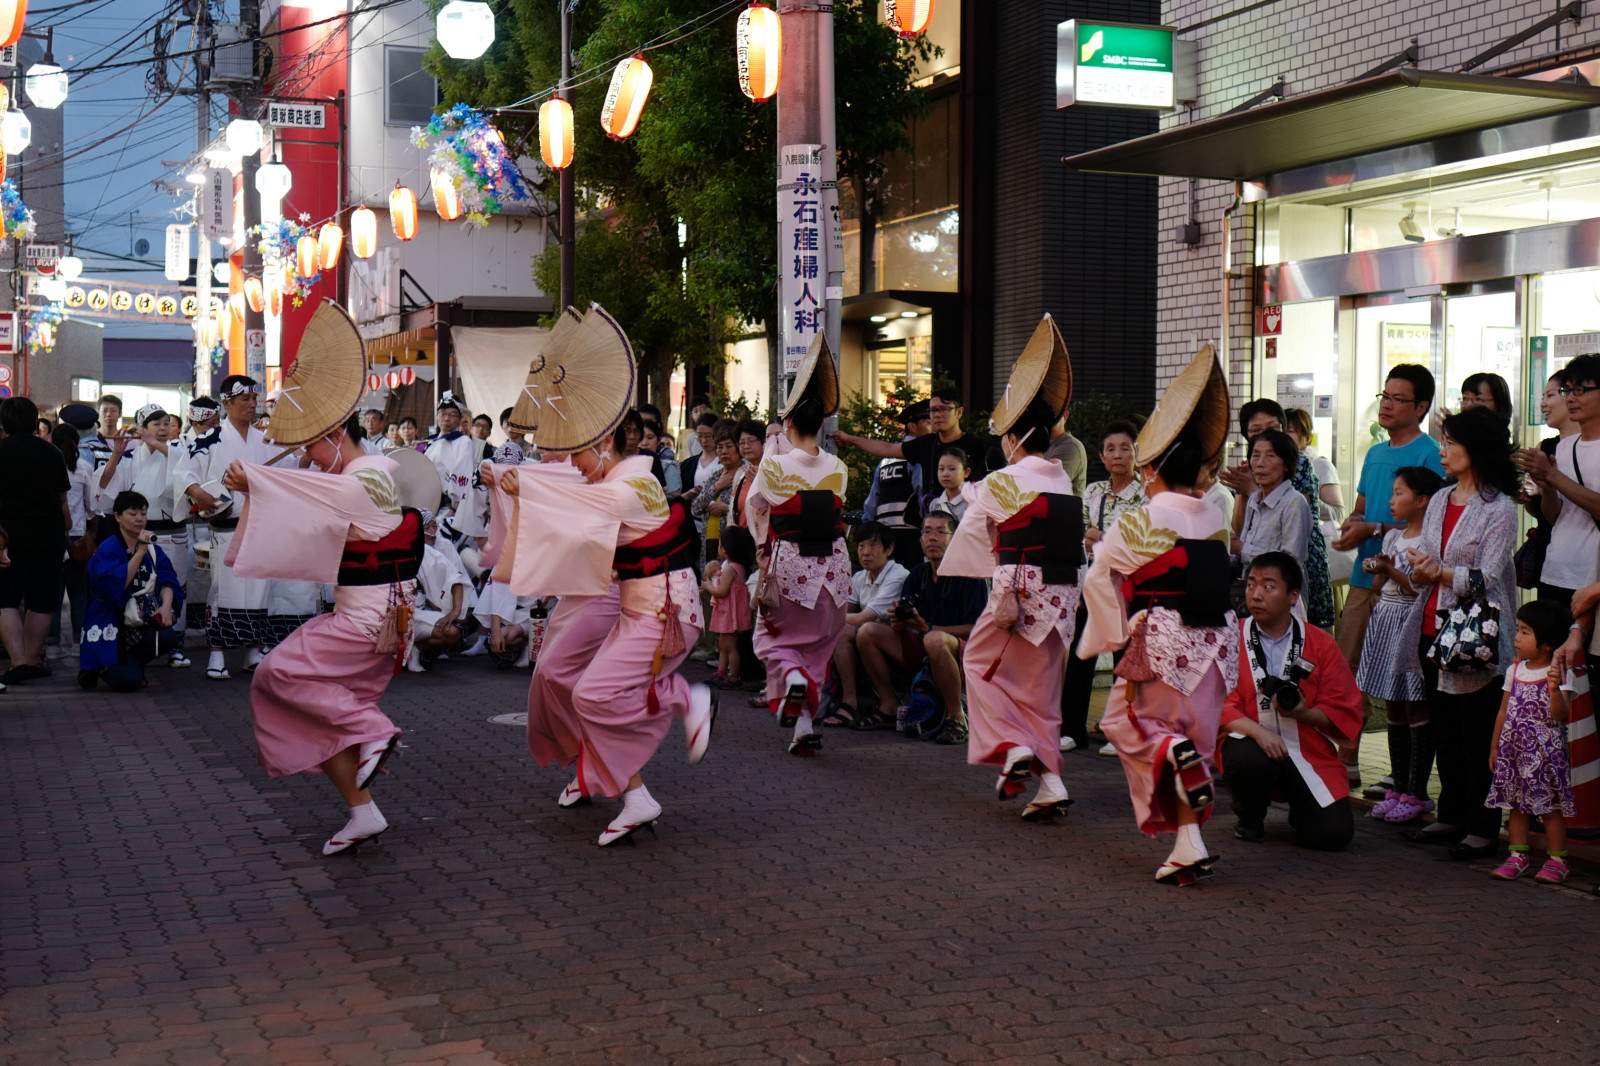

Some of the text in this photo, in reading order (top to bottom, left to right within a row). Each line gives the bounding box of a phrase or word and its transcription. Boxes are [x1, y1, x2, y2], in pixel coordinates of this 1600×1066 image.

[1103, 54, 1127, 65] SMBC
[793, 173, 819, 334] 永石産婦人科
[1264, 306, 1281, 315] AED
